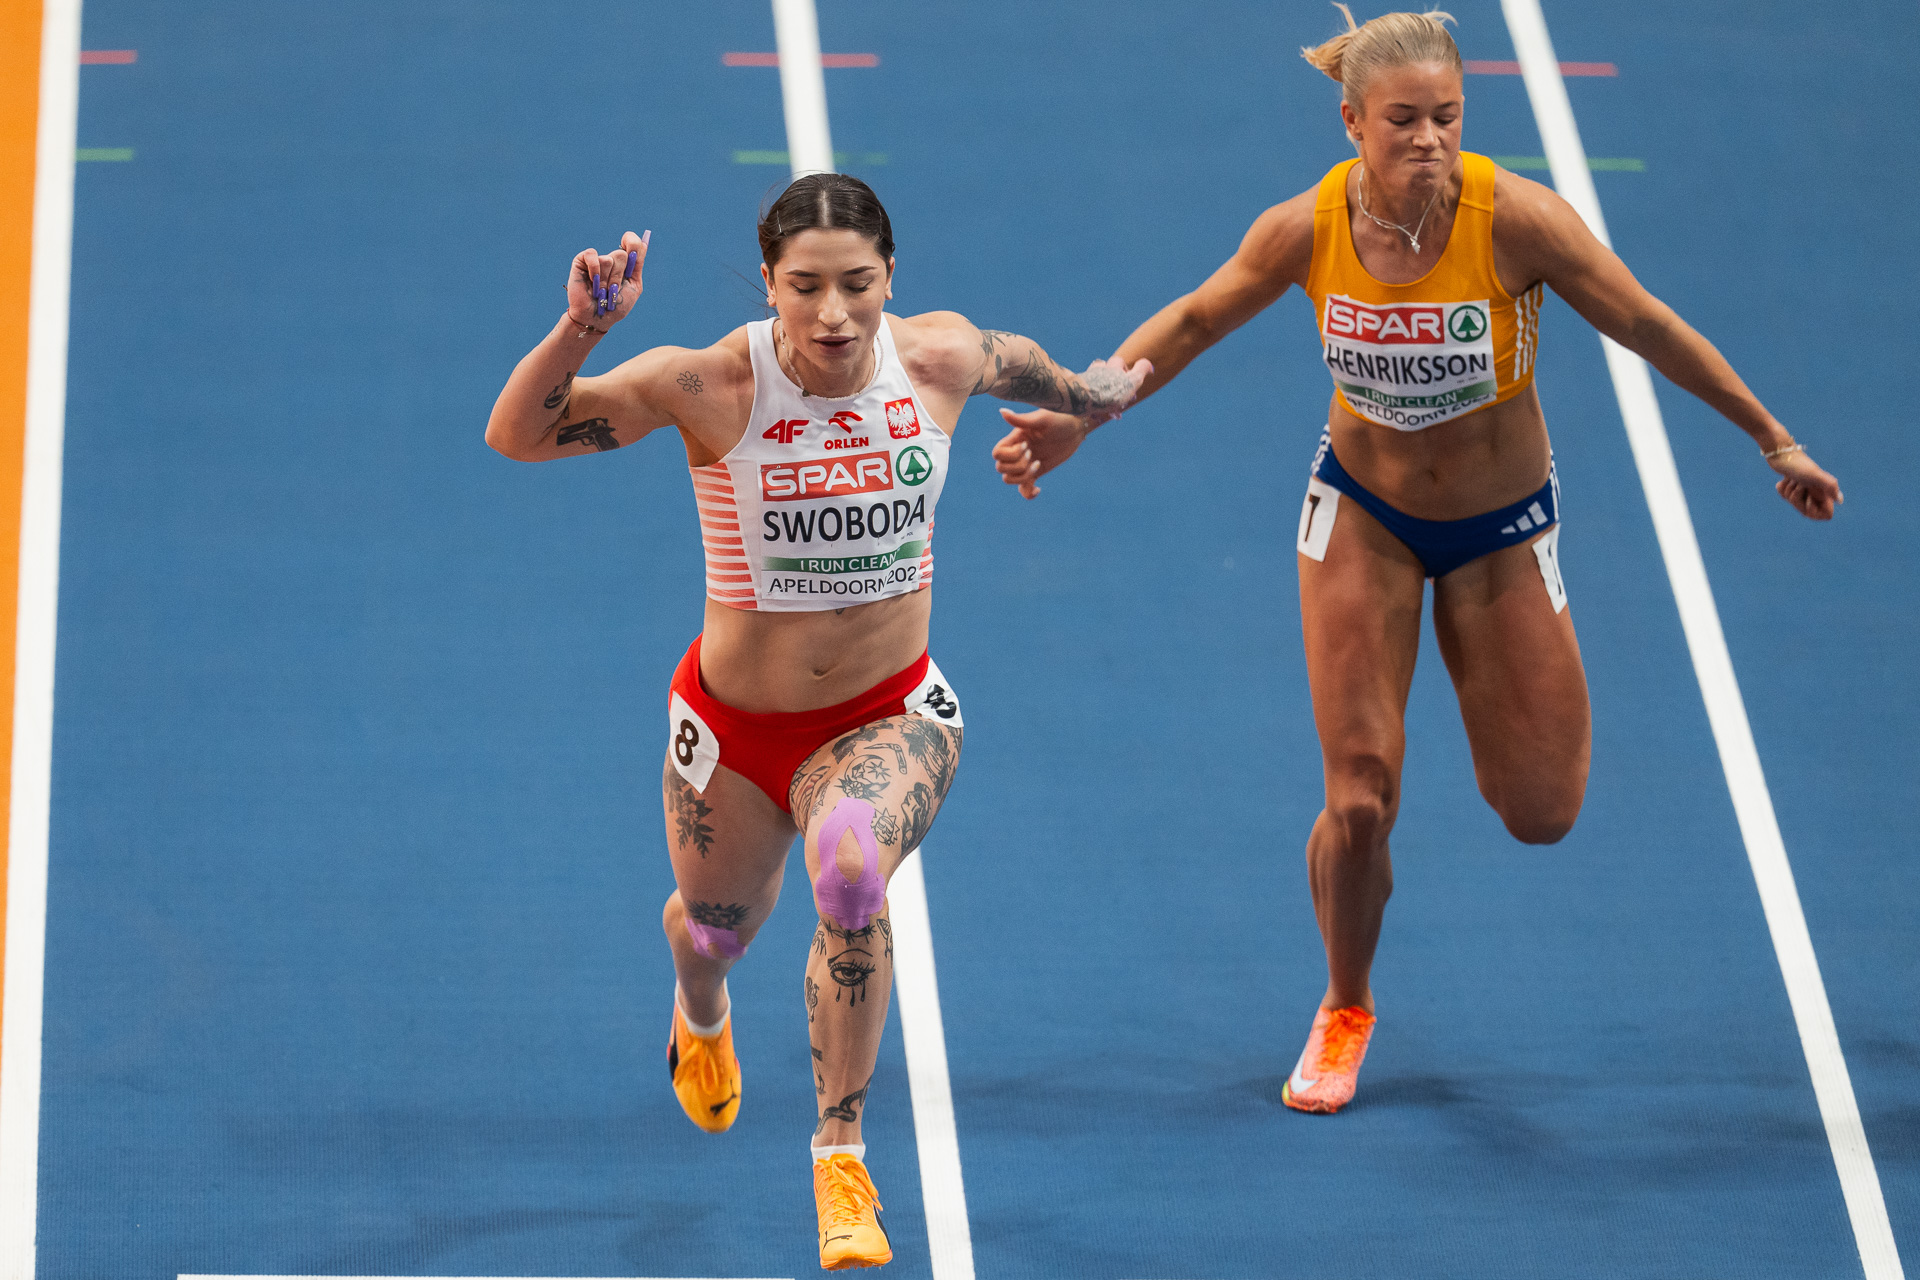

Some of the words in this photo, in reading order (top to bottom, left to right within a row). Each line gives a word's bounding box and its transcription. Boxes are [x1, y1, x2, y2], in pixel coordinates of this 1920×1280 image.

[1330, 304, 1441, 340] SPAR
[1327, 343, 1487, 385] HENRIKSSON
[1365, 388, 1369, 397] I
[1372, 390, 1402, 407] RUN
[1405, 392, 1457, 407] CLEAN
[763, 419, 809, 444] 4F
[824, 437, 869, 450] ORLEN
[766, 457, 889, 496] SPAR
[763, 494, 925, 542] SWOBODA
[801, 561, 804, 571] I
[807, 560, 844, 572] RUN
[849, 550, 897, 570] CLEAN
[769, 576, 887, 595] APELDOORN
[886, 566, 917, 584] 202
[675, 718, 699, 766] 8
